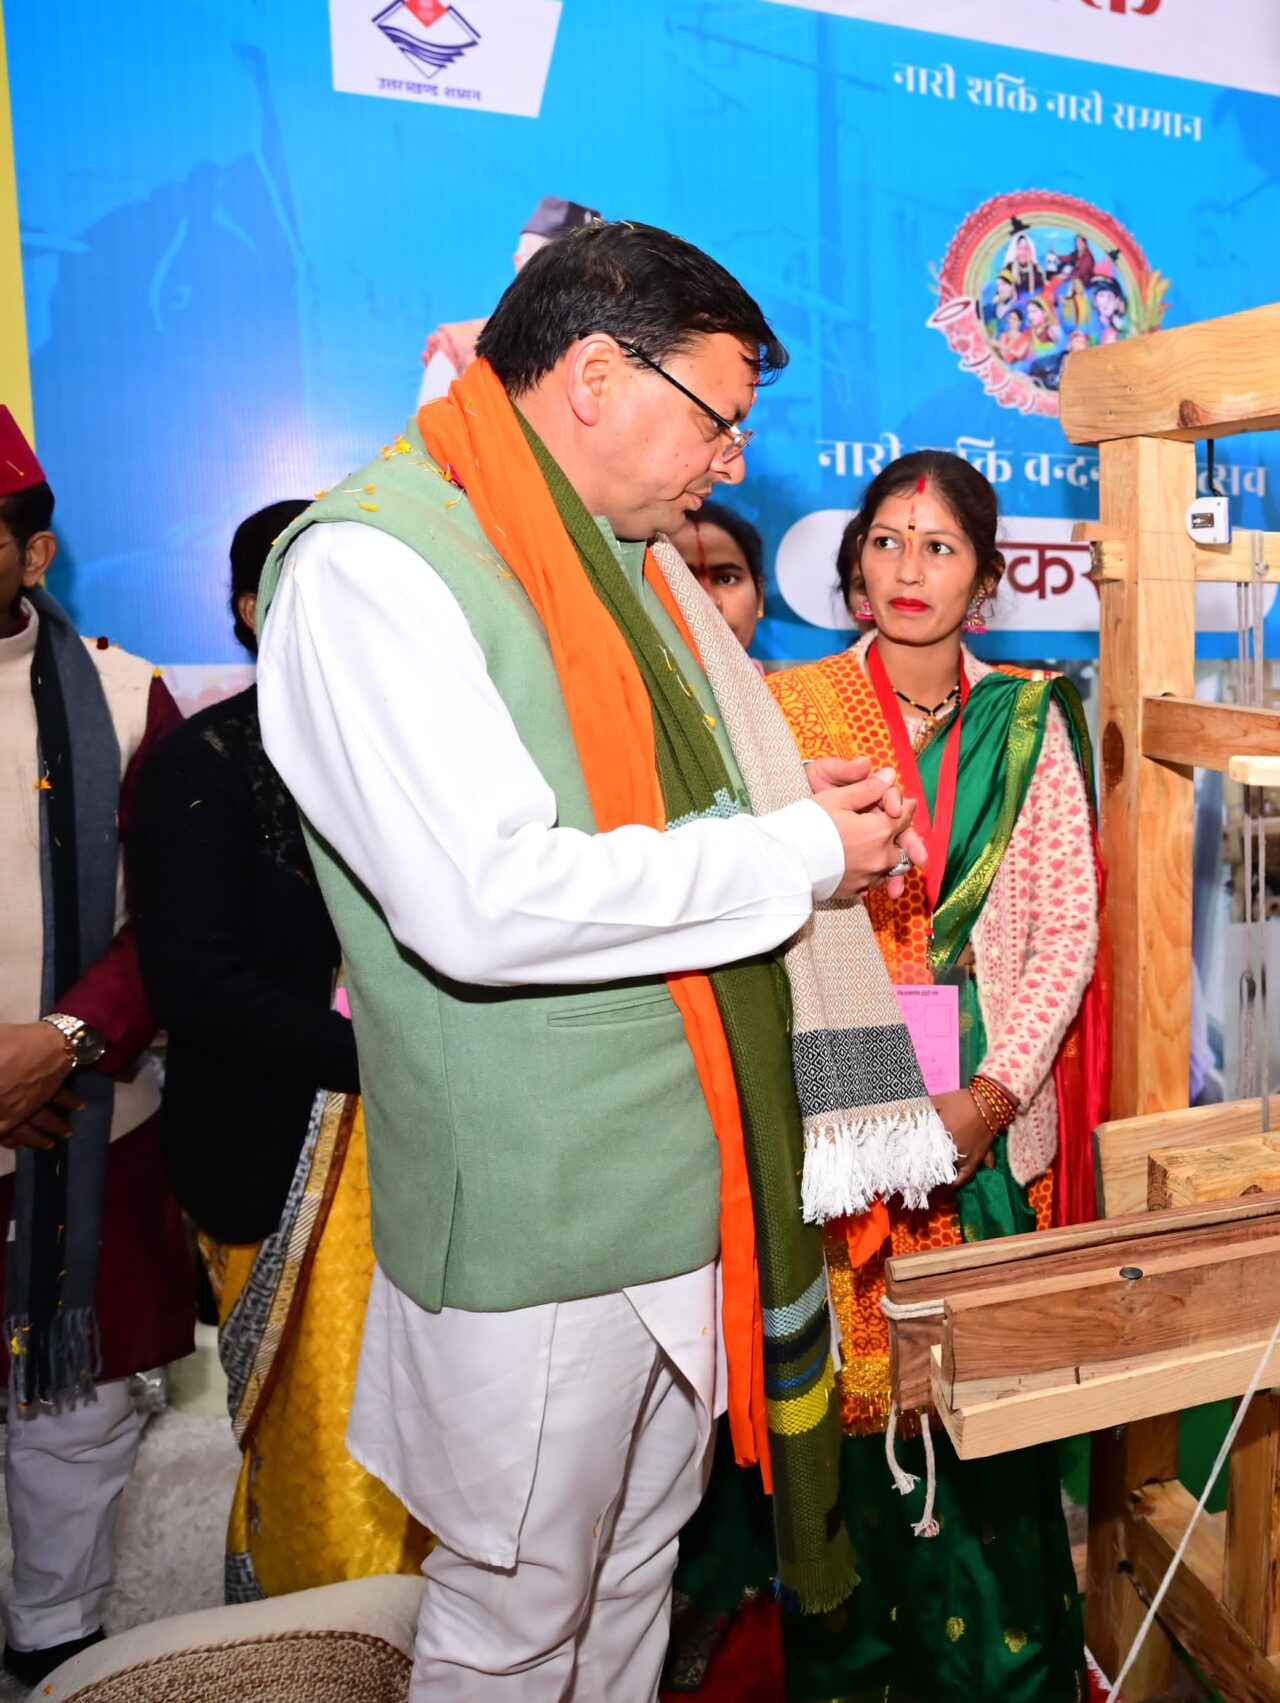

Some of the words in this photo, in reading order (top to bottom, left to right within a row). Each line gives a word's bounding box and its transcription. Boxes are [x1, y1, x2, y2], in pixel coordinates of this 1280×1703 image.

[893, 62, 956, 100] नारी
[1044, 90, 1102, 125] नारी
[1111, 101, 1204, 142] सम्मान
